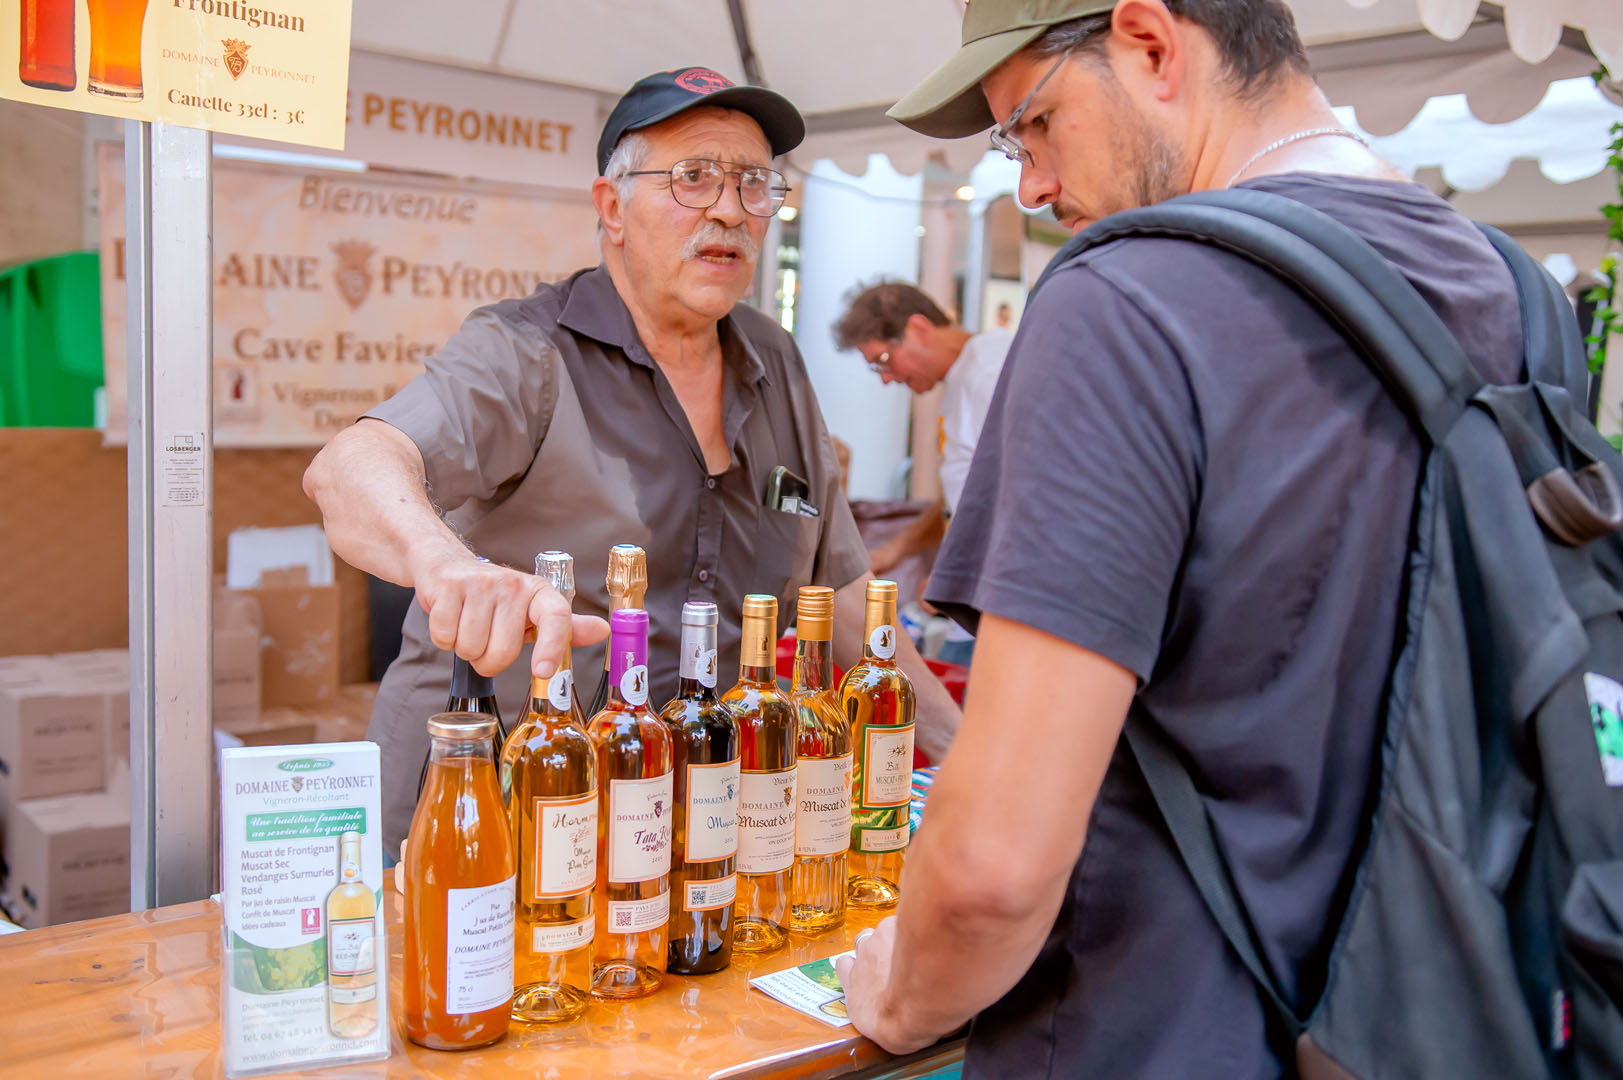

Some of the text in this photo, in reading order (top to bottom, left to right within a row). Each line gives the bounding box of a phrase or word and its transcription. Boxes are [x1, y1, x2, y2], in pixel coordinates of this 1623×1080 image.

[162, 48, 317, 85] DOMAINE PEYRONNET
[168, 88, 233, 113] Canette
[236, 102, 268, 118] 33cl
[362, 91, 574, 153] PEYRONNET
[299, 175, 478, 224] Bienvenue
[233, 327, 324, 362] Cave
[235, 775, 375, 795] DOMAINE PEYRONNET
[806, 786, 845, 794] DOMAINE
[693, 795, 728, 805] DOMAINE
[742, 801, 785, 810] DOMAINE
[800, 800, 839, 812] Muscat
[273, 814, 316, 825] tradition
[315, 810, 363, 826] familiale
[616, 813, 655, 821] DOMAINE
[707, 815, 735, 830] Muscat
[738, 814, 788, 828] Muscat de
[267, 828, 298, 837] service
[300, 824, 311, 834] de
[312, 823, 323, 833] la
[324, 822, 360, 835] qualité
[634, 829, 657, 845] Tata
[241, 845, 334, 859] Muscat de Frontignan
[241, 860, 289, 871] Muscat Sec
[241, 873, 289, 884] Vendanges
[241, 885, 263, 895] Rosé
[253, 898, 263, 908] jus
[264, 897, 273, 905] de
[274, 896, 292, 905] raisin
[241, 908, 295, 919] Confit de Muscat
[488, 913, 495, 921] de
[260, 920, 286, 929] cadeaux
[463, 926, 487, 936] Muscat
[488, 923, 503, 931] Petits
[454, 942, 491, 954] DOMAINE
[242, 995, 325, 1012] Domaine Peyronnet
